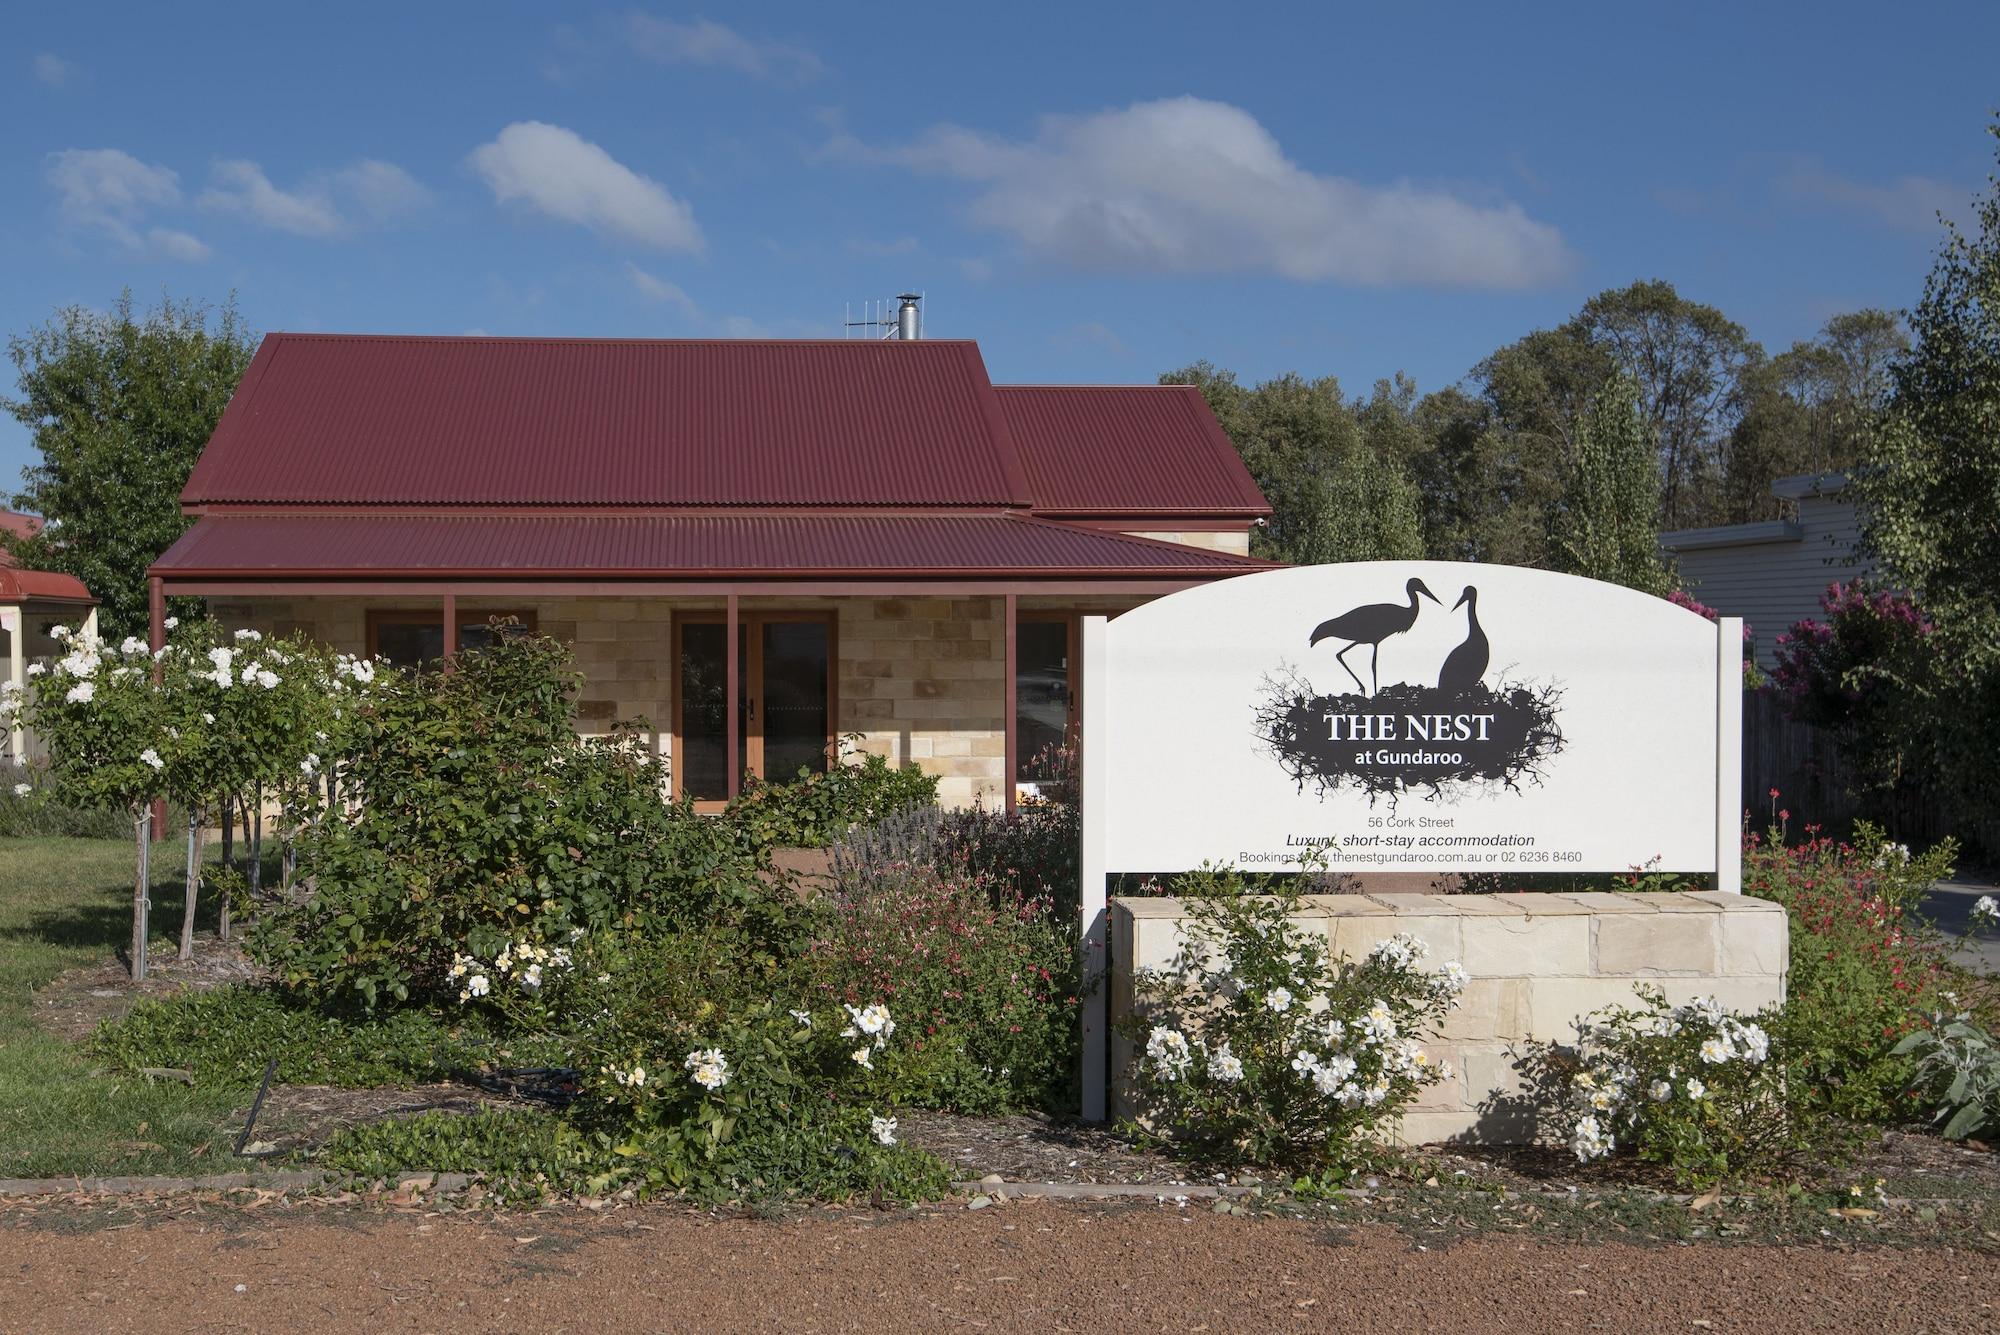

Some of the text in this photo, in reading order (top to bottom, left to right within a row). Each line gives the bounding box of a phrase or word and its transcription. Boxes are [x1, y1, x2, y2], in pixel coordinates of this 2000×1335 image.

[1323, 713, 1495, 741] THE NEST
[1354, 749, 1463, 765] at Gundaroo
[1367, 816, 1455, 828] 56 Cork Street
[1342, 834, 1416, 849] short-stay
[1418, 834, 1535, 847] accommodation
[1485, 854, 1498, 863] or
[1500, 851, 1516, 863] 02
[1519, 851, 1550, 863] 6236
[1552, 851, 1583, 863] 8460
